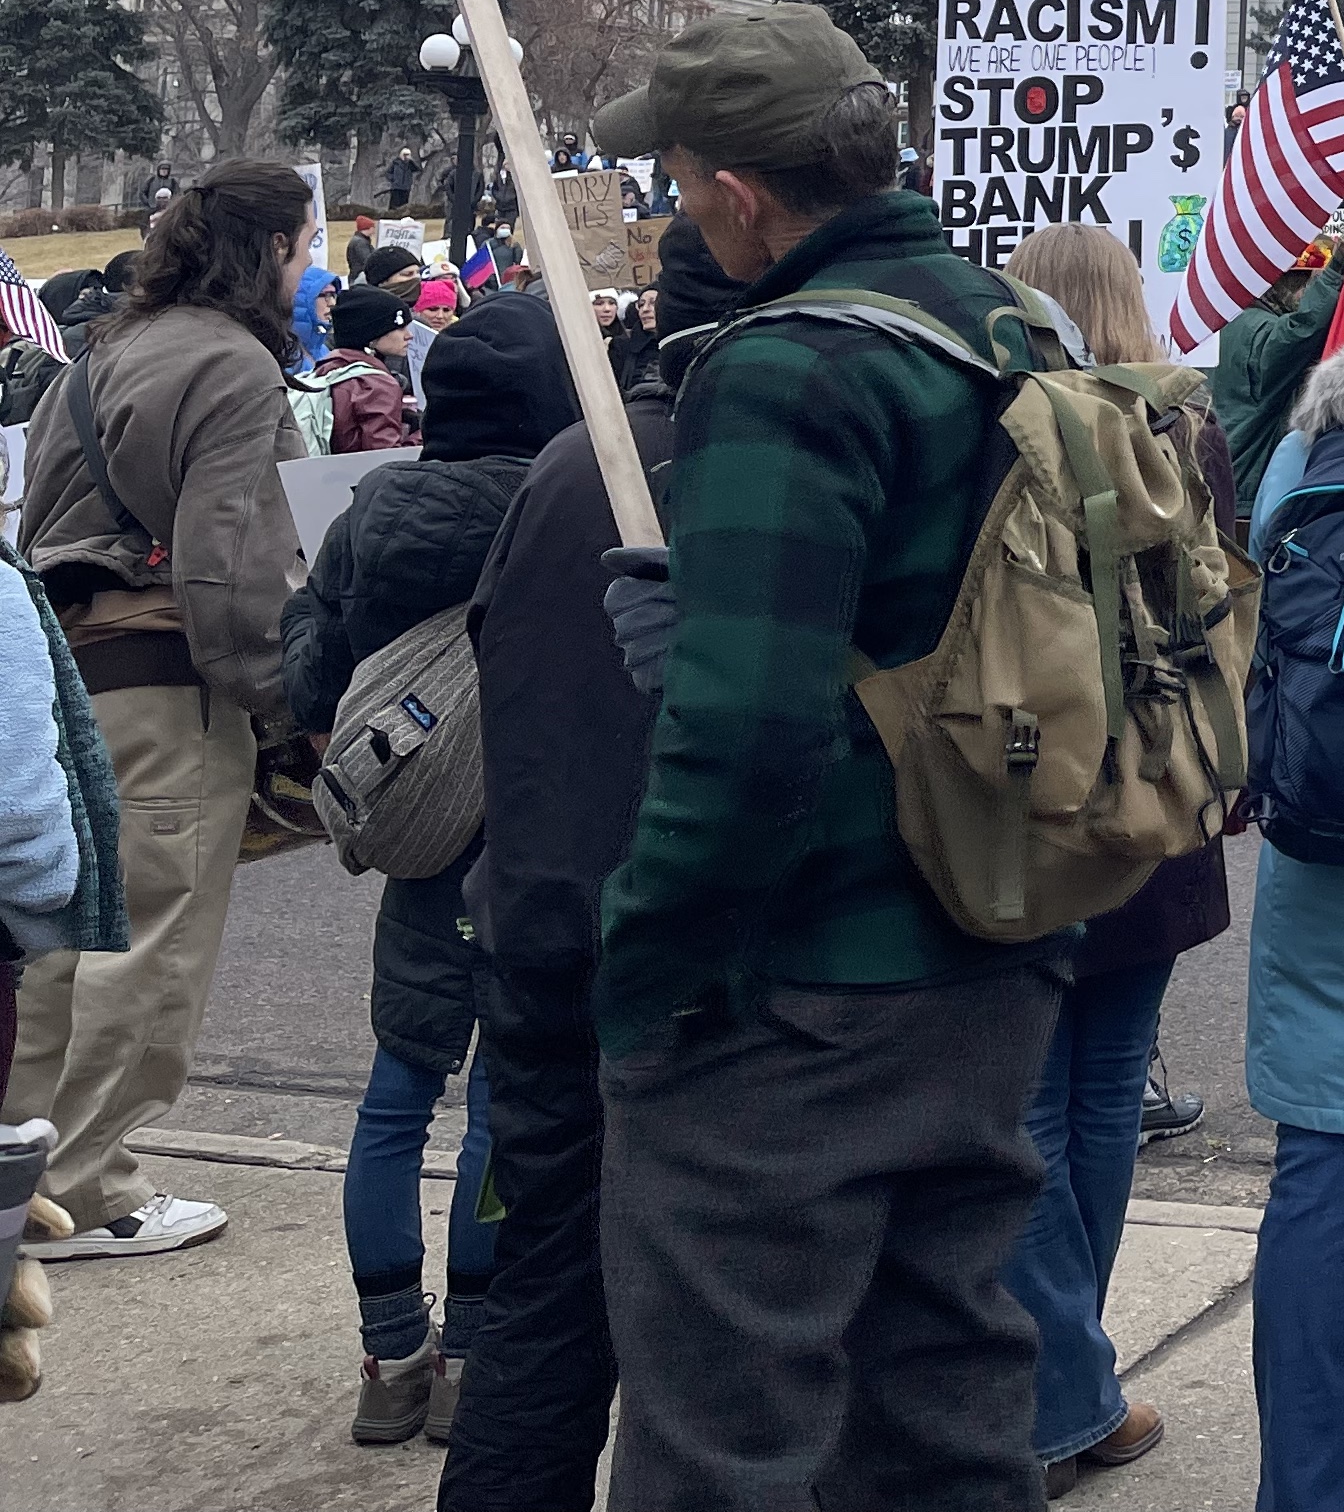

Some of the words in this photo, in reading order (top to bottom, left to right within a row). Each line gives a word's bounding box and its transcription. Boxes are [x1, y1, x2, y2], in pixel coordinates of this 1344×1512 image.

[948, 45, 981, 73] WE
[988, 44, 1022, 74] ARE
[1031, 44, 1068, 72] ONE
[939, 74, 1105, 126] STOP
[557, 172, 613, 204] TORY
[940, 175, 1113, 228] BANK
[573, 204, 609, 231] ILS
